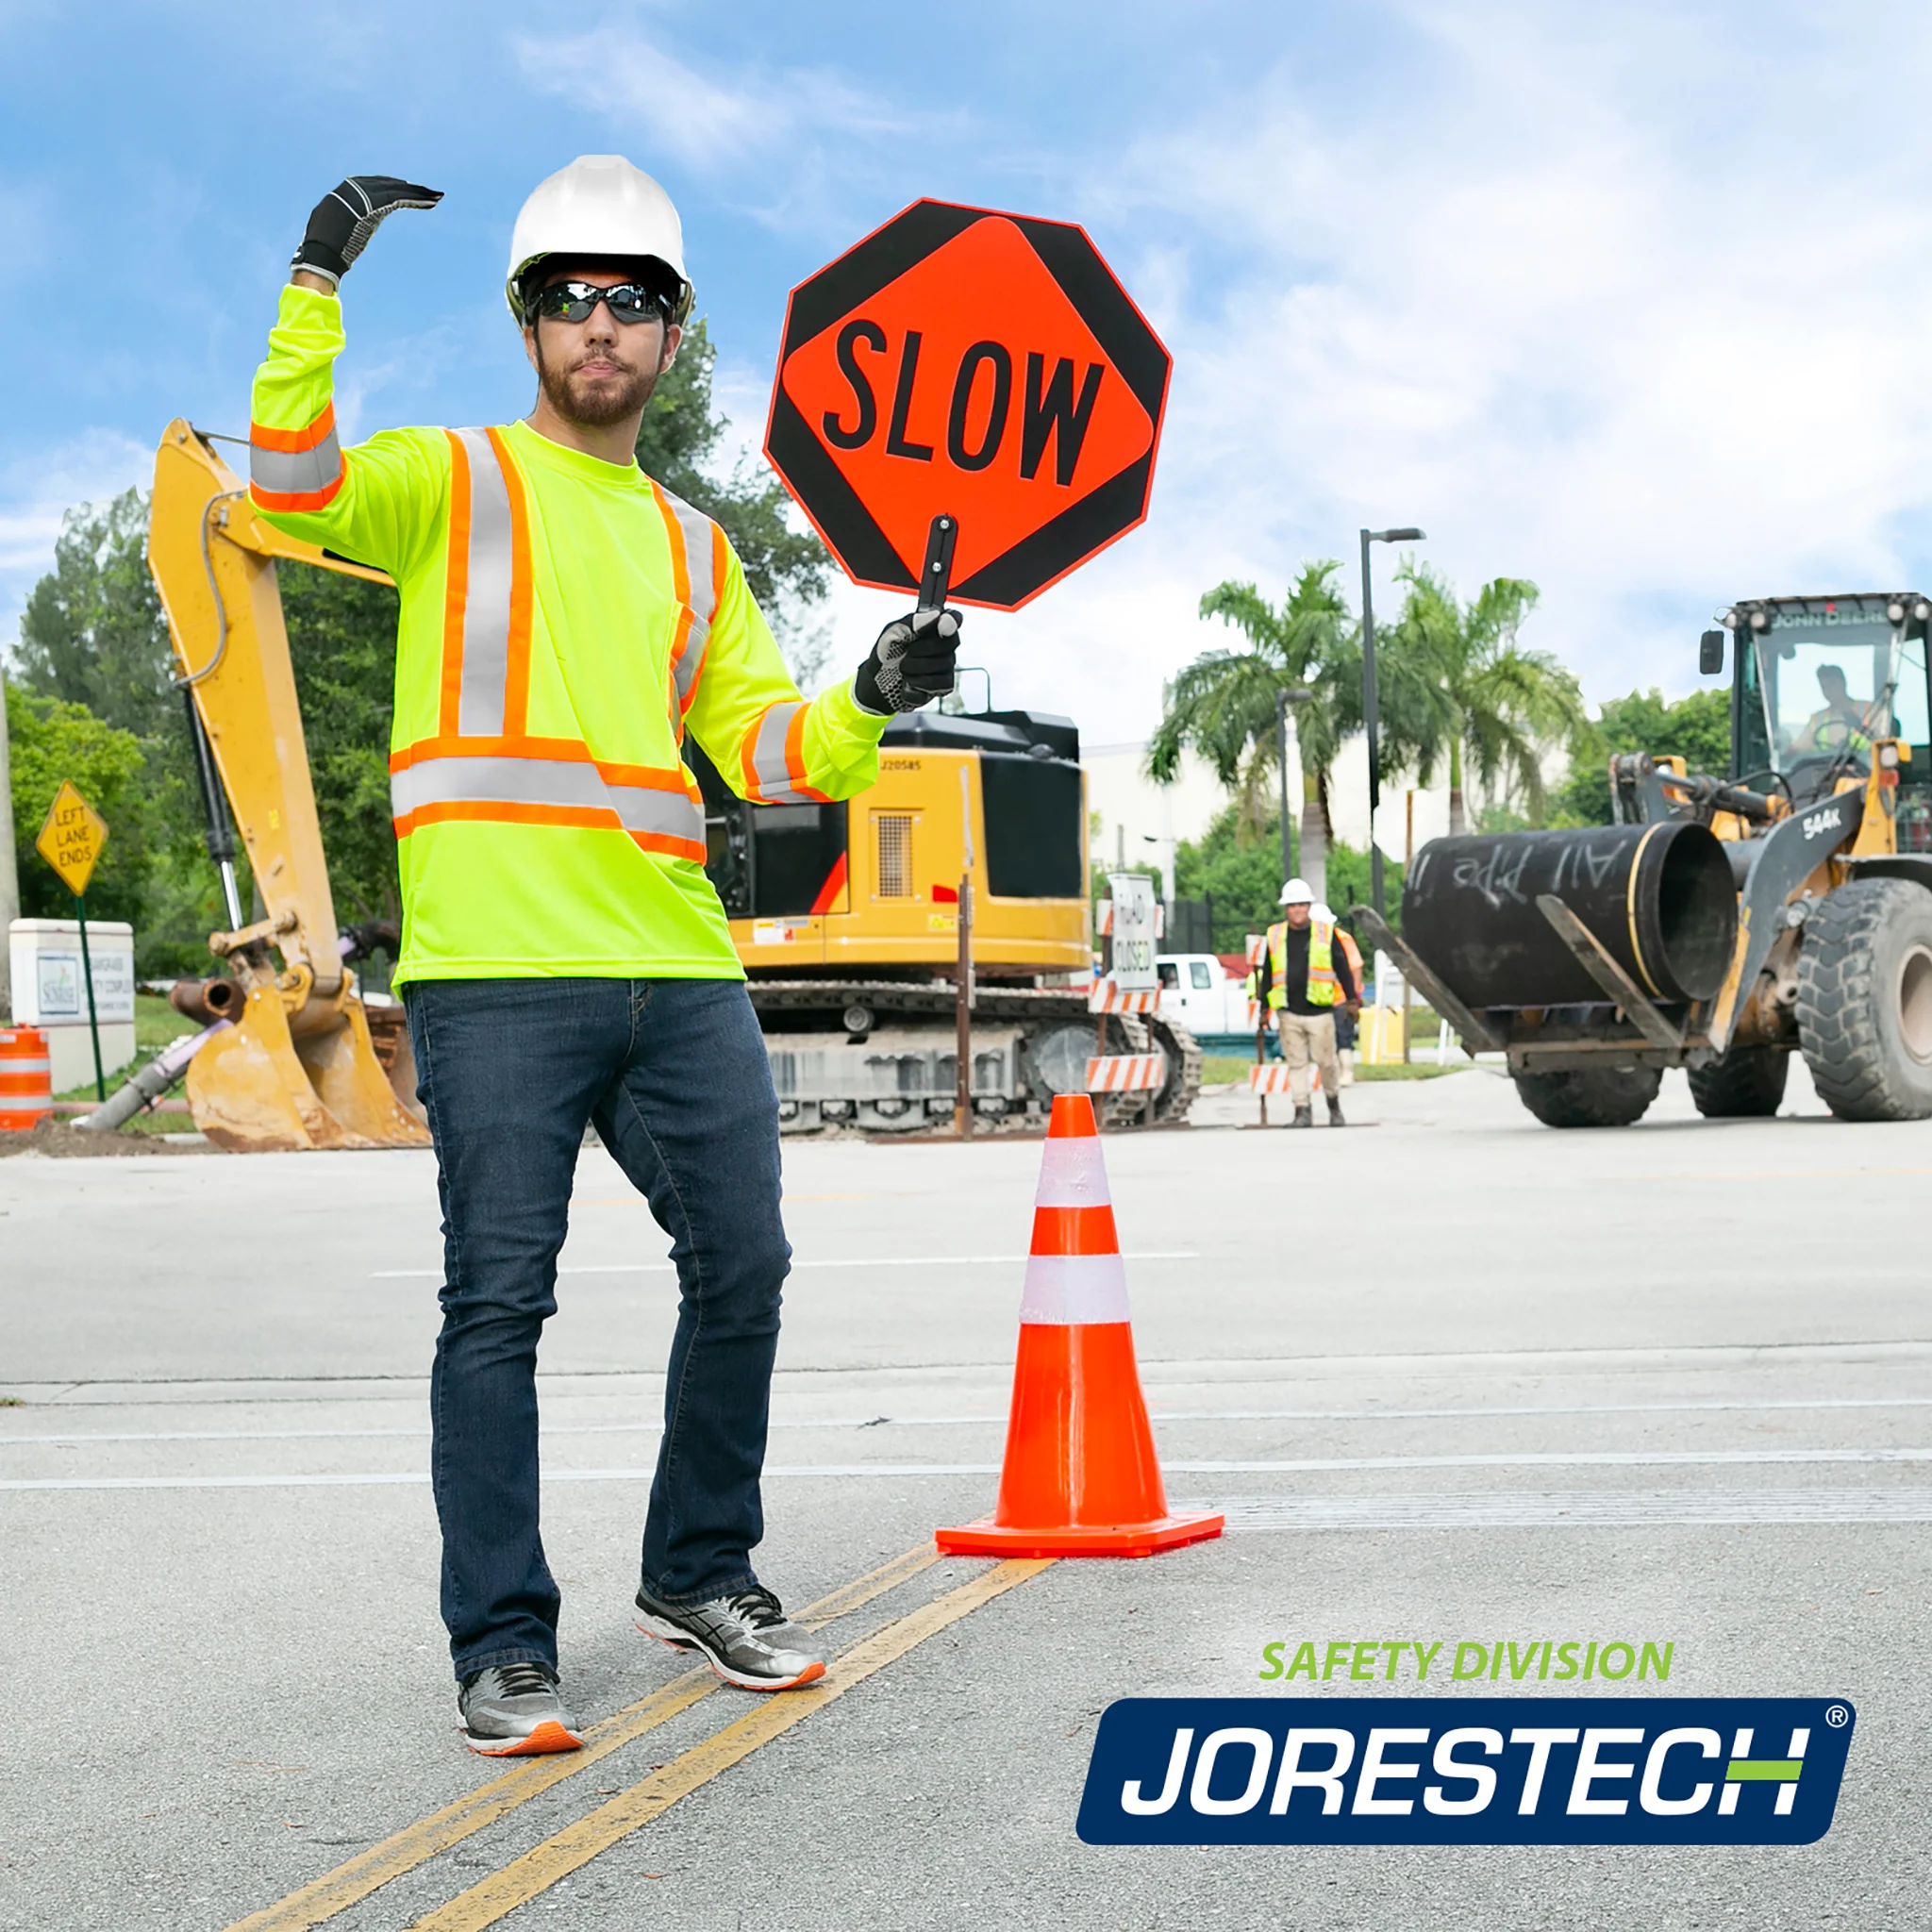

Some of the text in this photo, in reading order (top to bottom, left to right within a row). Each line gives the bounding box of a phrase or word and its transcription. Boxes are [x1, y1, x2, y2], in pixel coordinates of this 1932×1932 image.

[823, 320, 1105, 487] SLOW
[1772, 613, 1822, 629] JOHN
[56, 806, 85, 827] LEFT
[1803, 808, 1842, 841] 544K
[57, 825, 91, 847] LANE
[58, 845, 92, 867] ENDS
